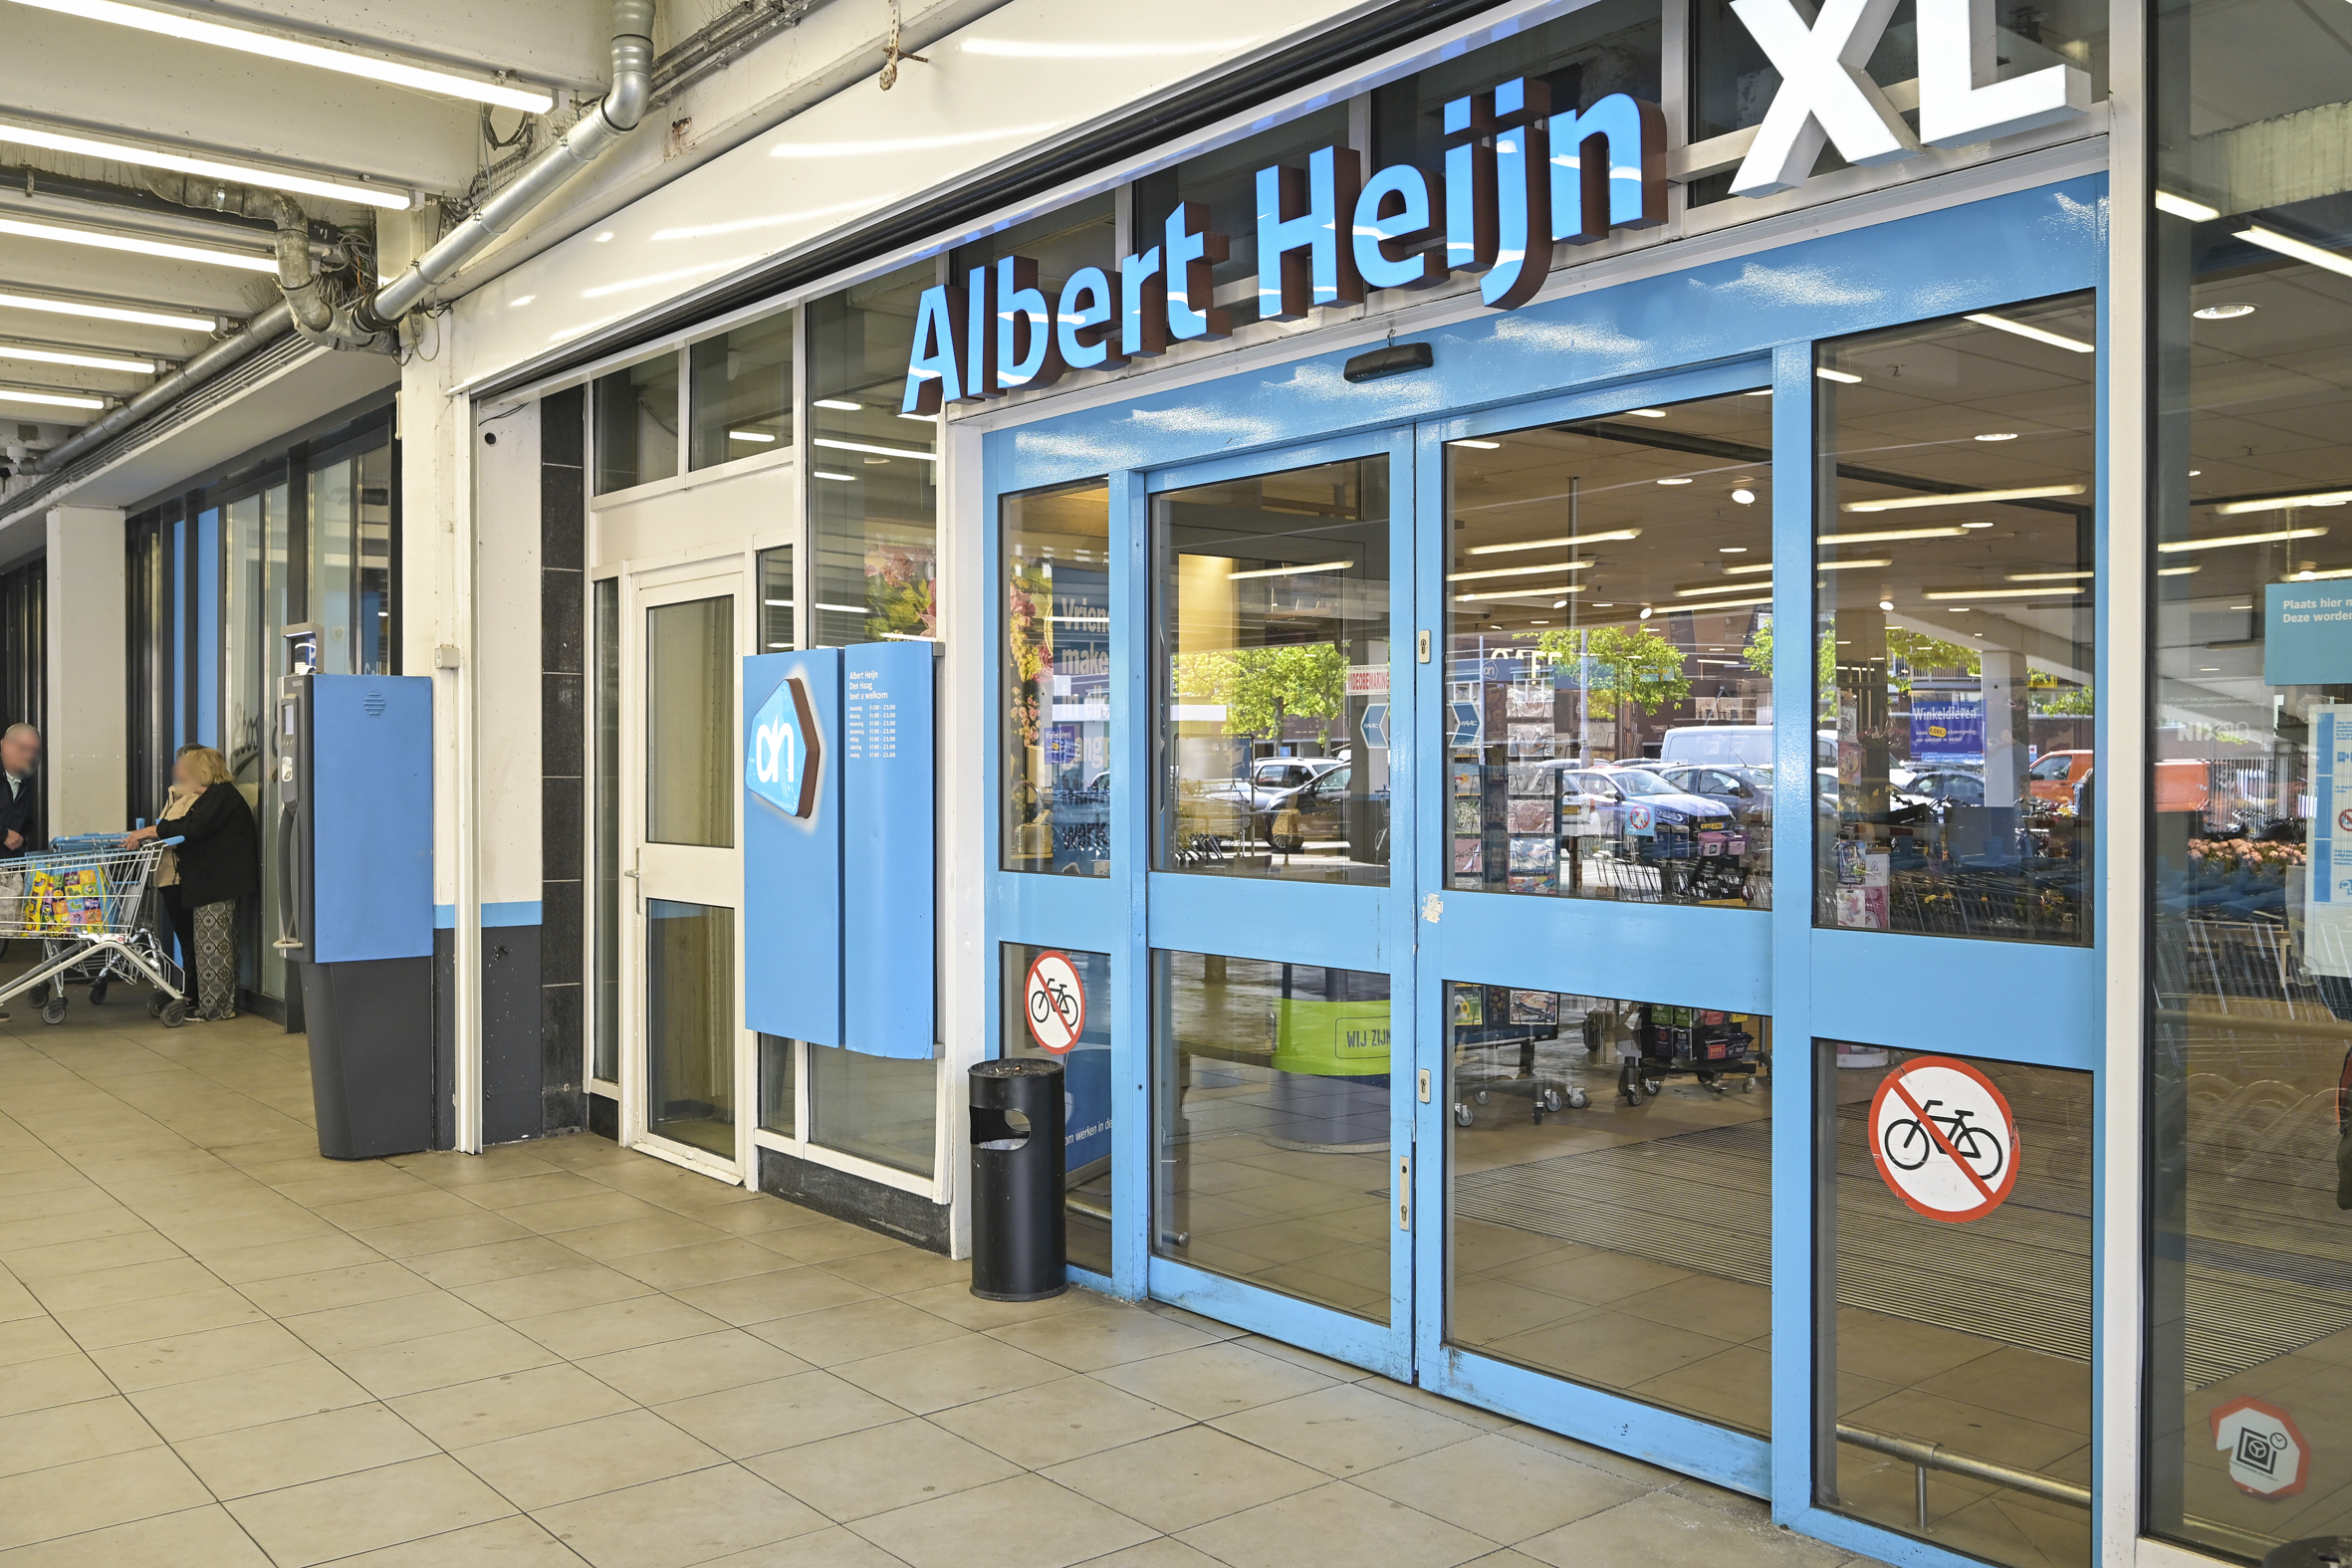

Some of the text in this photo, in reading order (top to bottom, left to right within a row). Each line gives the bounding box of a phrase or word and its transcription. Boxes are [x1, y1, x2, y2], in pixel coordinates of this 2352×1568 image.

[900, 0, 2073, 415] Albert Heijn XL
[2283, 599, 2317, 609] Plaats
[2320, 598, 2343, 607] hier
[1061, 597, 1109, 632] Vrien
[2283, 613, 2310, 623] Deze
[849, 669, 878, 680] Albert Heijn
[859, 681, 872, 691] Haag
[1913, 706, 1977, 721] Winkeldieven
[1346, 1030, 1367, 1047] WIJ
[1075, 1125, 1097, 1142] werken
[1098, 1121, 1104, 1133] in
[1105, 1117, 1112, 1130] de
